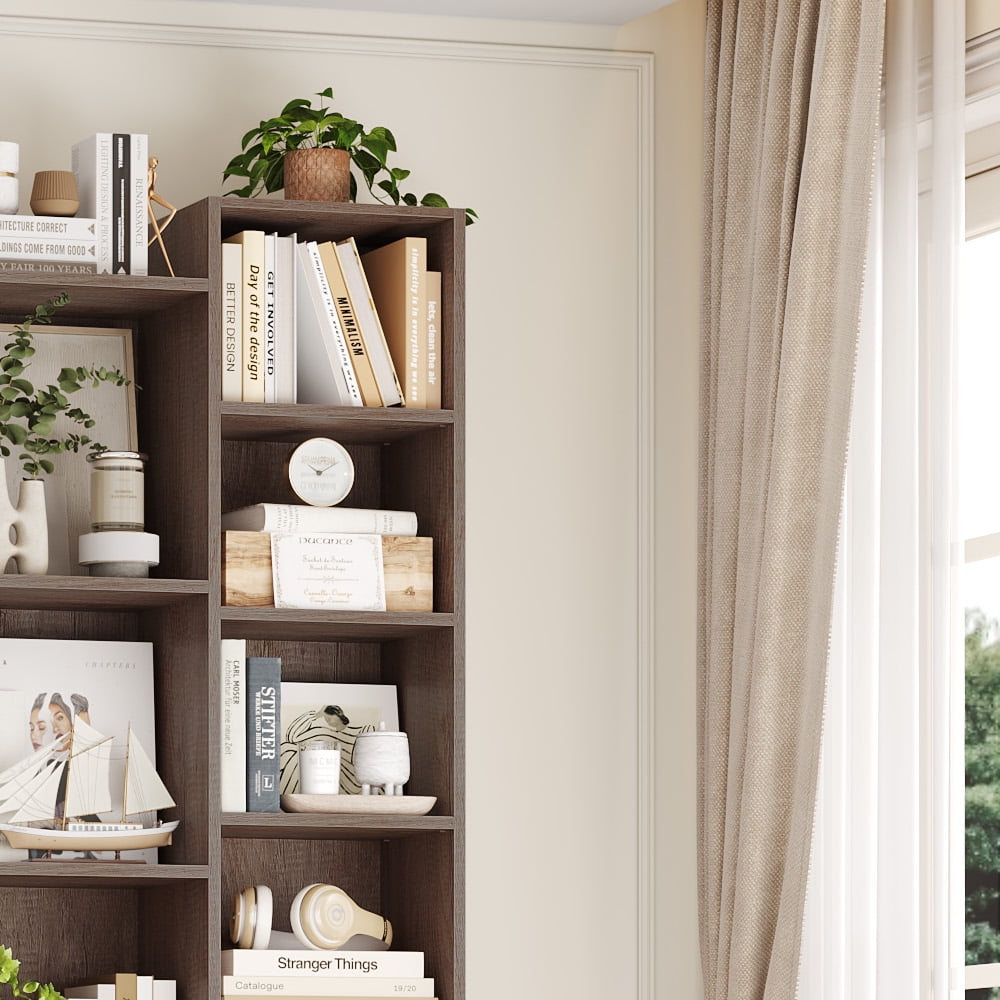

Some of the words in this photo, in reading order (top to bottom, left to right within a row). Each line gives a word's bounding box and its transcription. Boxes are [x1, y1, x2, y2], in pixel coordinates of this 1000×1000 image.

[100, 140, 109, 182] LIGHTING
[100, 183, 109, 215] DESIGN
[135, 178, 144, 248] RENAISSANCE
[36, 222, 68, 234] CORRECT
[24, 242, 44, 255] COME
[45, 243, 66, 255] FROM
[67, 243, 86, 256] GOOD
[100, 224, 108, 262] PROCESS
[11, 262, 35, 272] FAIR
[37, 264, 55, 273] 100
[58, 265, 92, 274] YEARS
[247, 265, 260, 292] Day
[407, 247, 419, 294] simplicity
[226, 282, 236, 323] BETTER
[250, 295, 260, 308] of
[411, 296, 419, 304] is
[411, 307, 419, 316] in
[250, 311, 260, 333] the
[336, 297, 364, 356] MINIMALISM
[226, 327, 236, 372] DESIGN
[267, 303, 275, 376] INVOLVED
[407, 319, 419, 368] everything
[428, 324, 437, 350] clean
[247, 336, 260, 381] design
[428, 352, 437, 369] the
[411, 370, 418, 383] we
[428, 371, 437, 385] air
[84, 661, 137, 670] CHAPTERS
[224, 659, 232, 697] Architektur
[232, 660, 240, 678] CARL
[232, 680, 240, 705] MOSER
[261, 686, 276, 761] STIFTER
[224, 742, 233, 755] Zeit
[277, 956, 332, 972] Stranger
[334, 957, 378, 973] Things
[235, 981, 284, 992] Catalogue
[393, 984, 417, 992] 19/20
